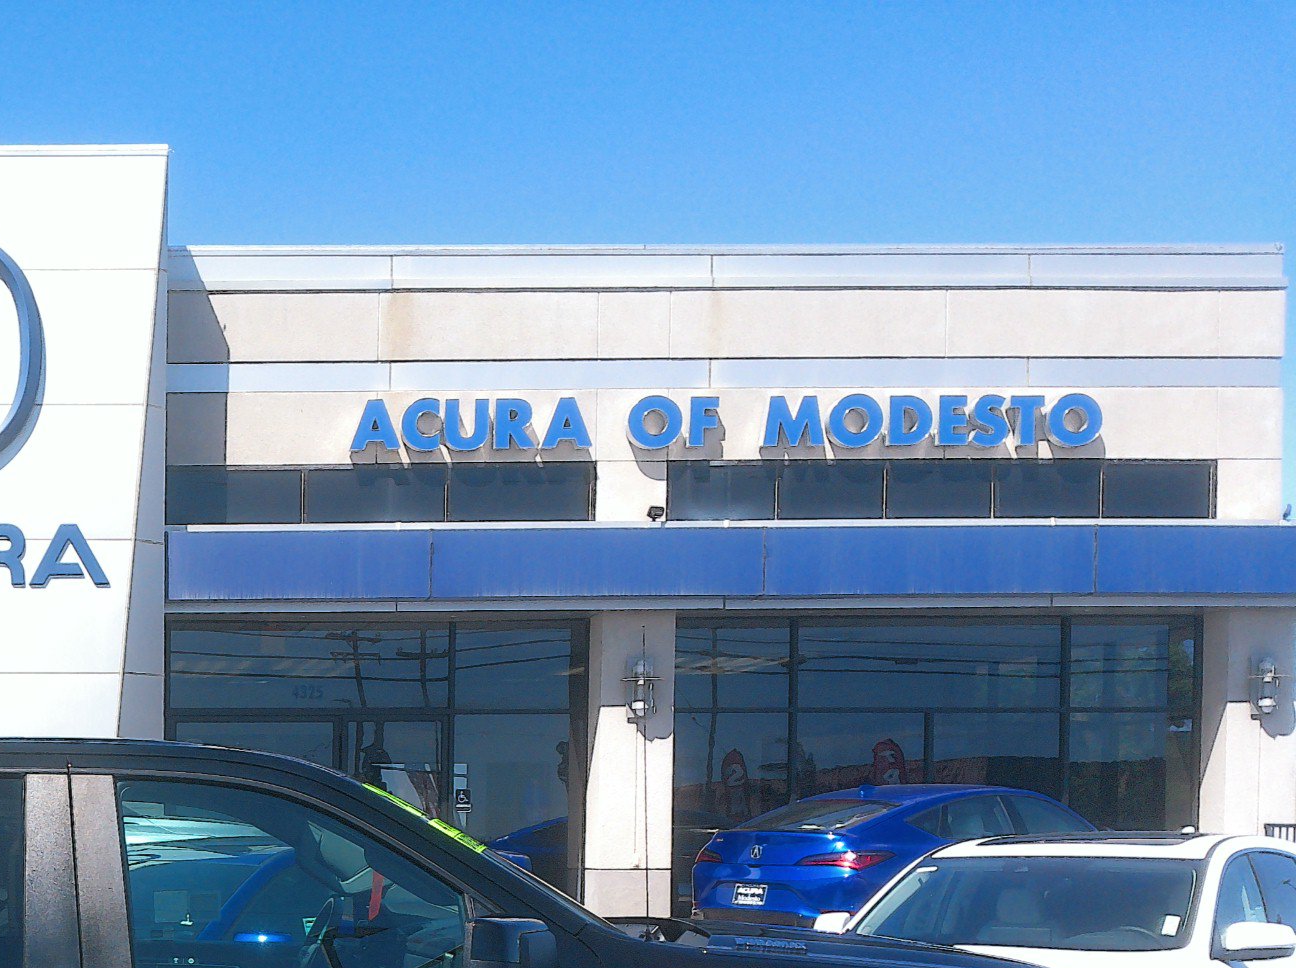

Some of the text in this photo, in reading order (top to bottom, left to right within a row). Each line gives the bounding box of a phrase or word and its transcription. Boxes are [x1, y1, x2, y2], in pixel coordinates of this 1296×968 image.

[351, 393, 1102, 451] ACURA OF MODESTO
